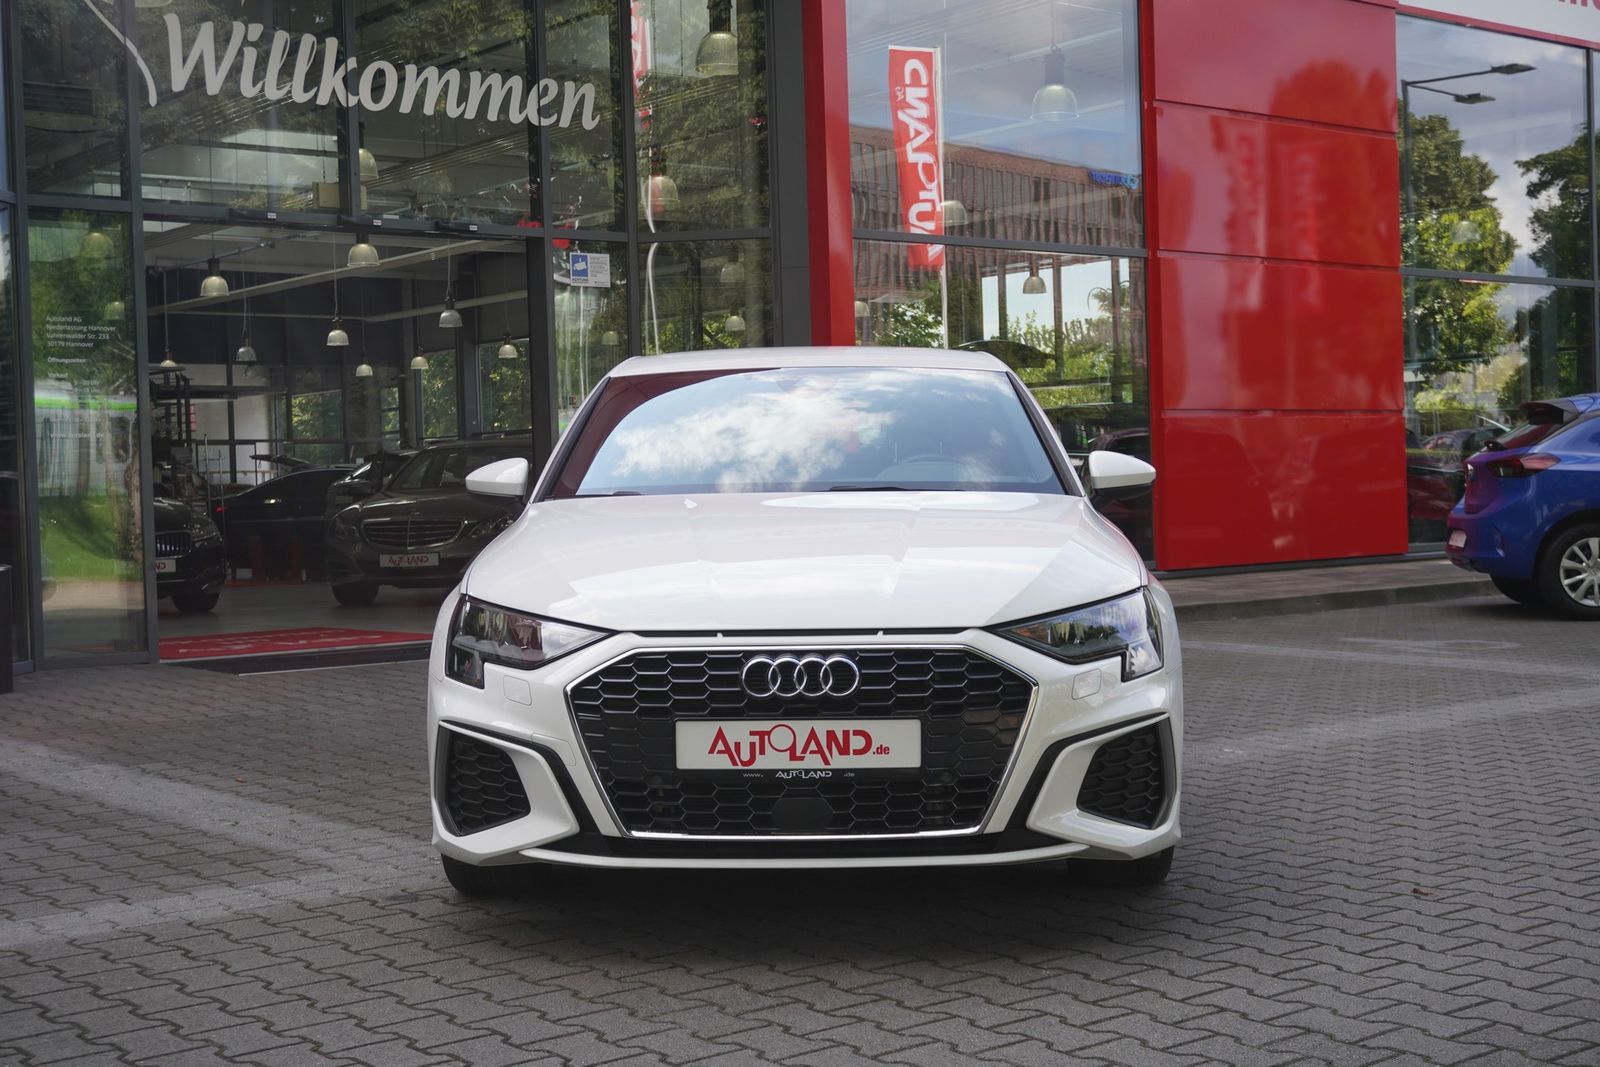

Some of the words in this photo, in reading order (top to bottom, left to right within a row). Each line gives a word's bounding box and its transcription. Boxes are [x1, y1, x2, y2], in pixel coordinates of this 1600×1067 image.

[163, 13, 600, 130] Willkommen
[46, 324, 88, 332] Niederlassung
[776, 769, 833, 779] AUTOLAND
